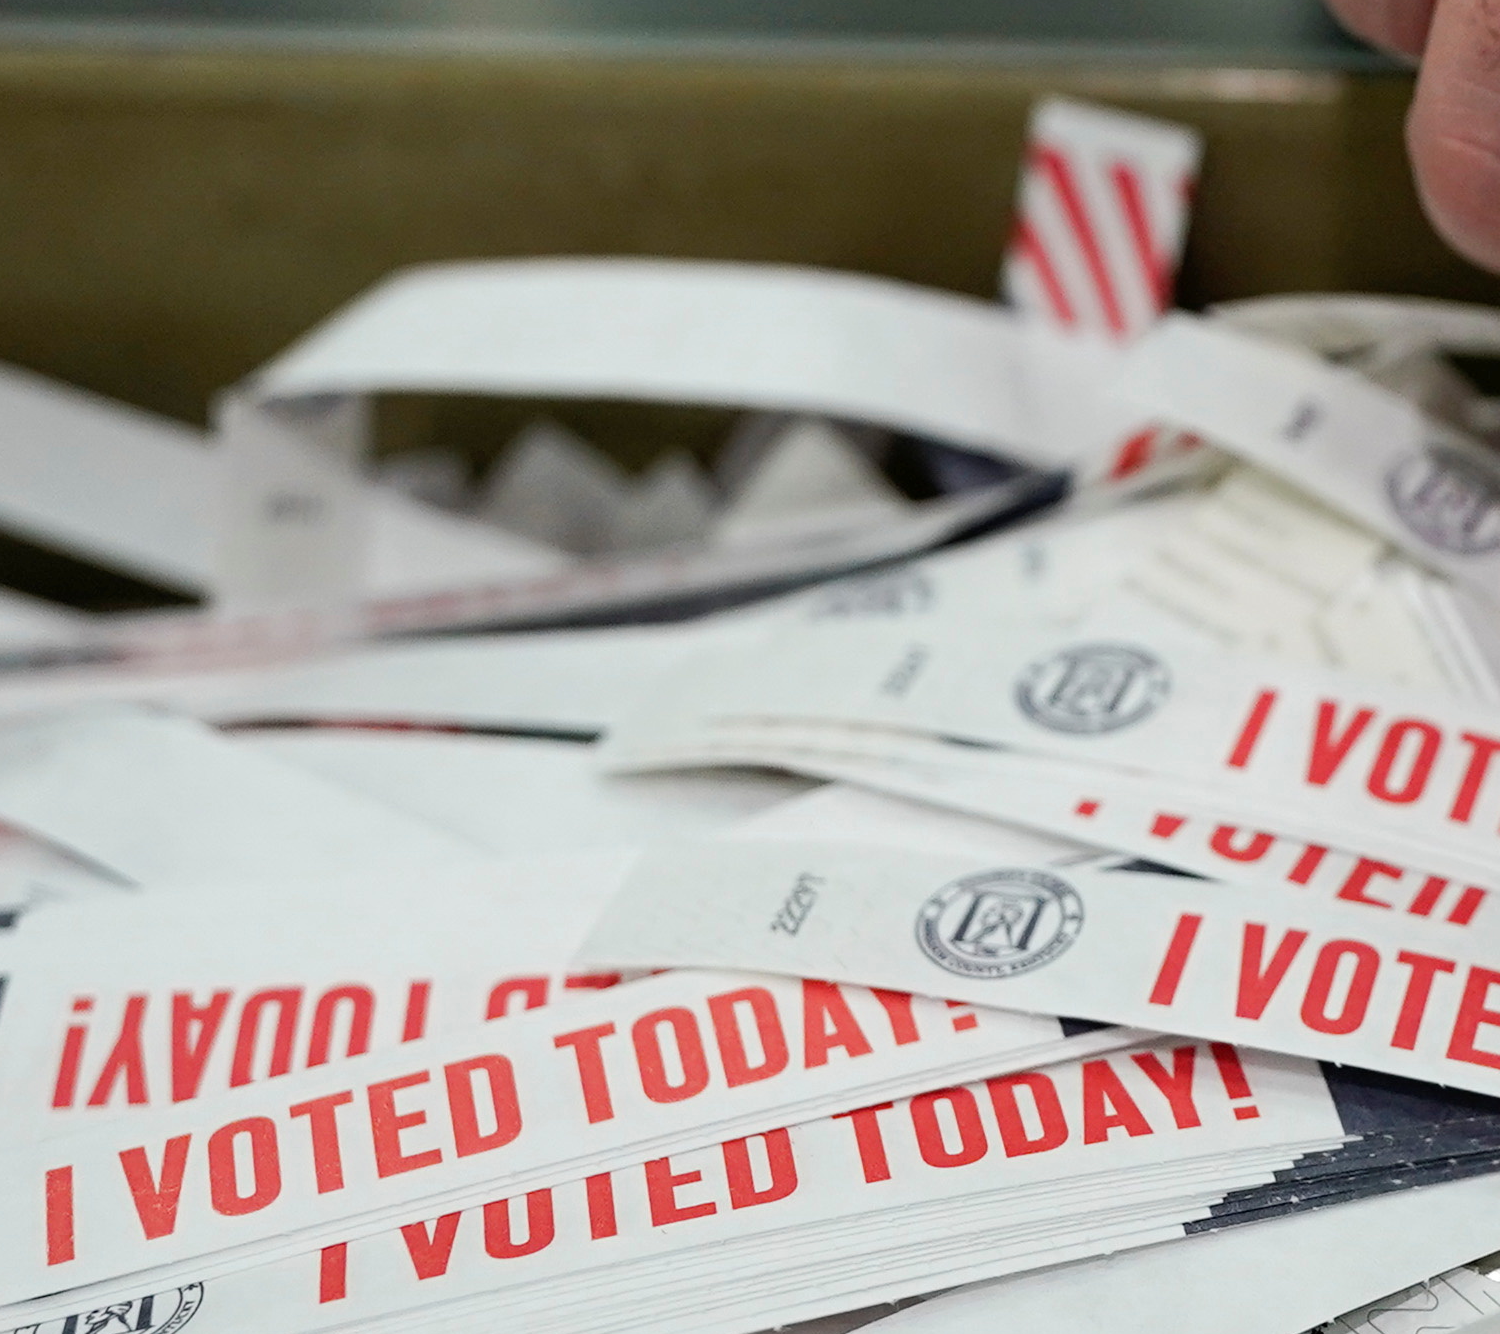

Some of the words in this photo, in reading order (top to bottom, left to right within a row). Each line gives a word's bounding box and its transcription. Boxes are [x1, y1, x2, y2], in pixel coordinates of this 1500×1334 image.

[1228, 687, 1278, 769] I
[1150, 912, 1203, 1006] I
[46, 1165, 74, 1266] I
[119, 1053, 522, 1240] VOTED
[833, 1043, 1261, 1184] TODAY!
